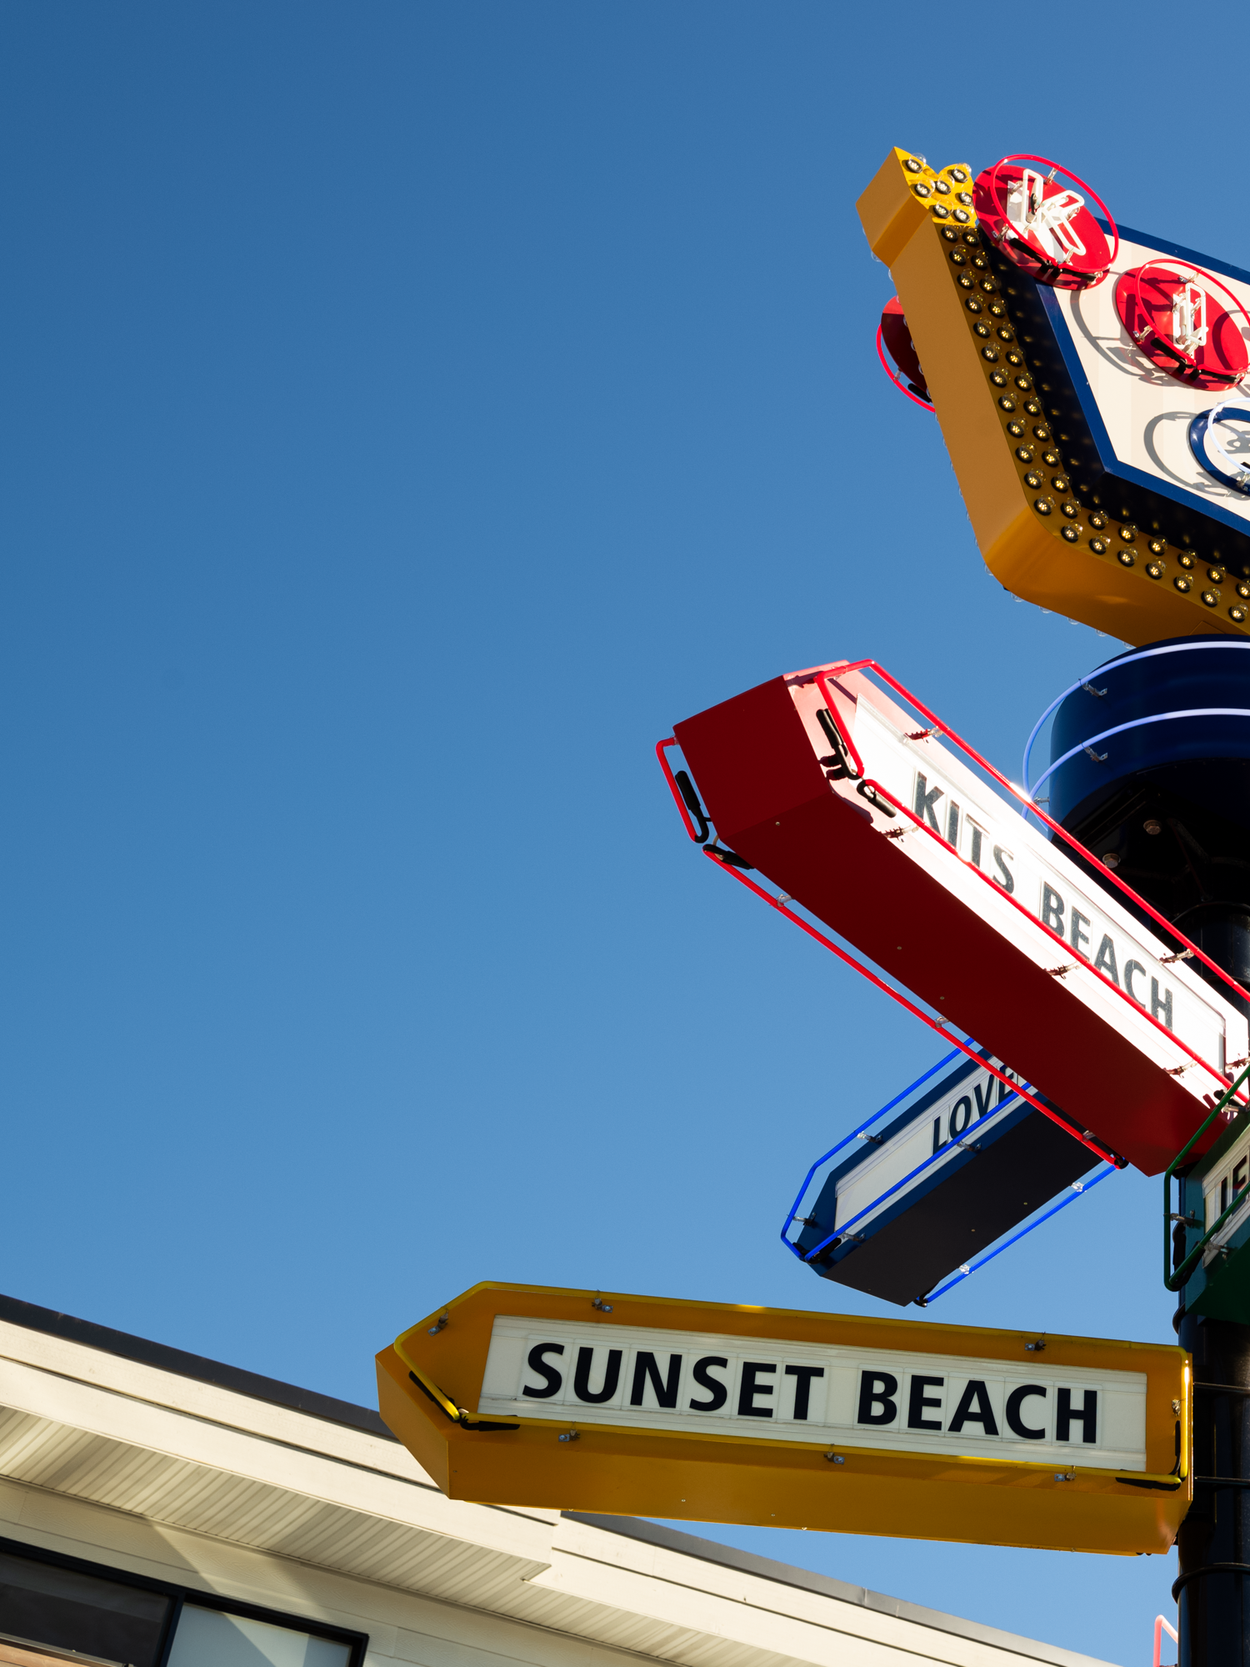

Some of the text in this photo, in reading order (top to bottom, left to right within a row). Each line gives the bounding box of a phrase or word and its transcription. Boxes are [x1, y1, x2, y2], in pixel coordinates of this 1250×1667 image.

[911, 771, 1175, 1032] KITS BEACH
[521, 1341, 1098, 1444] SUNSET BEACH
